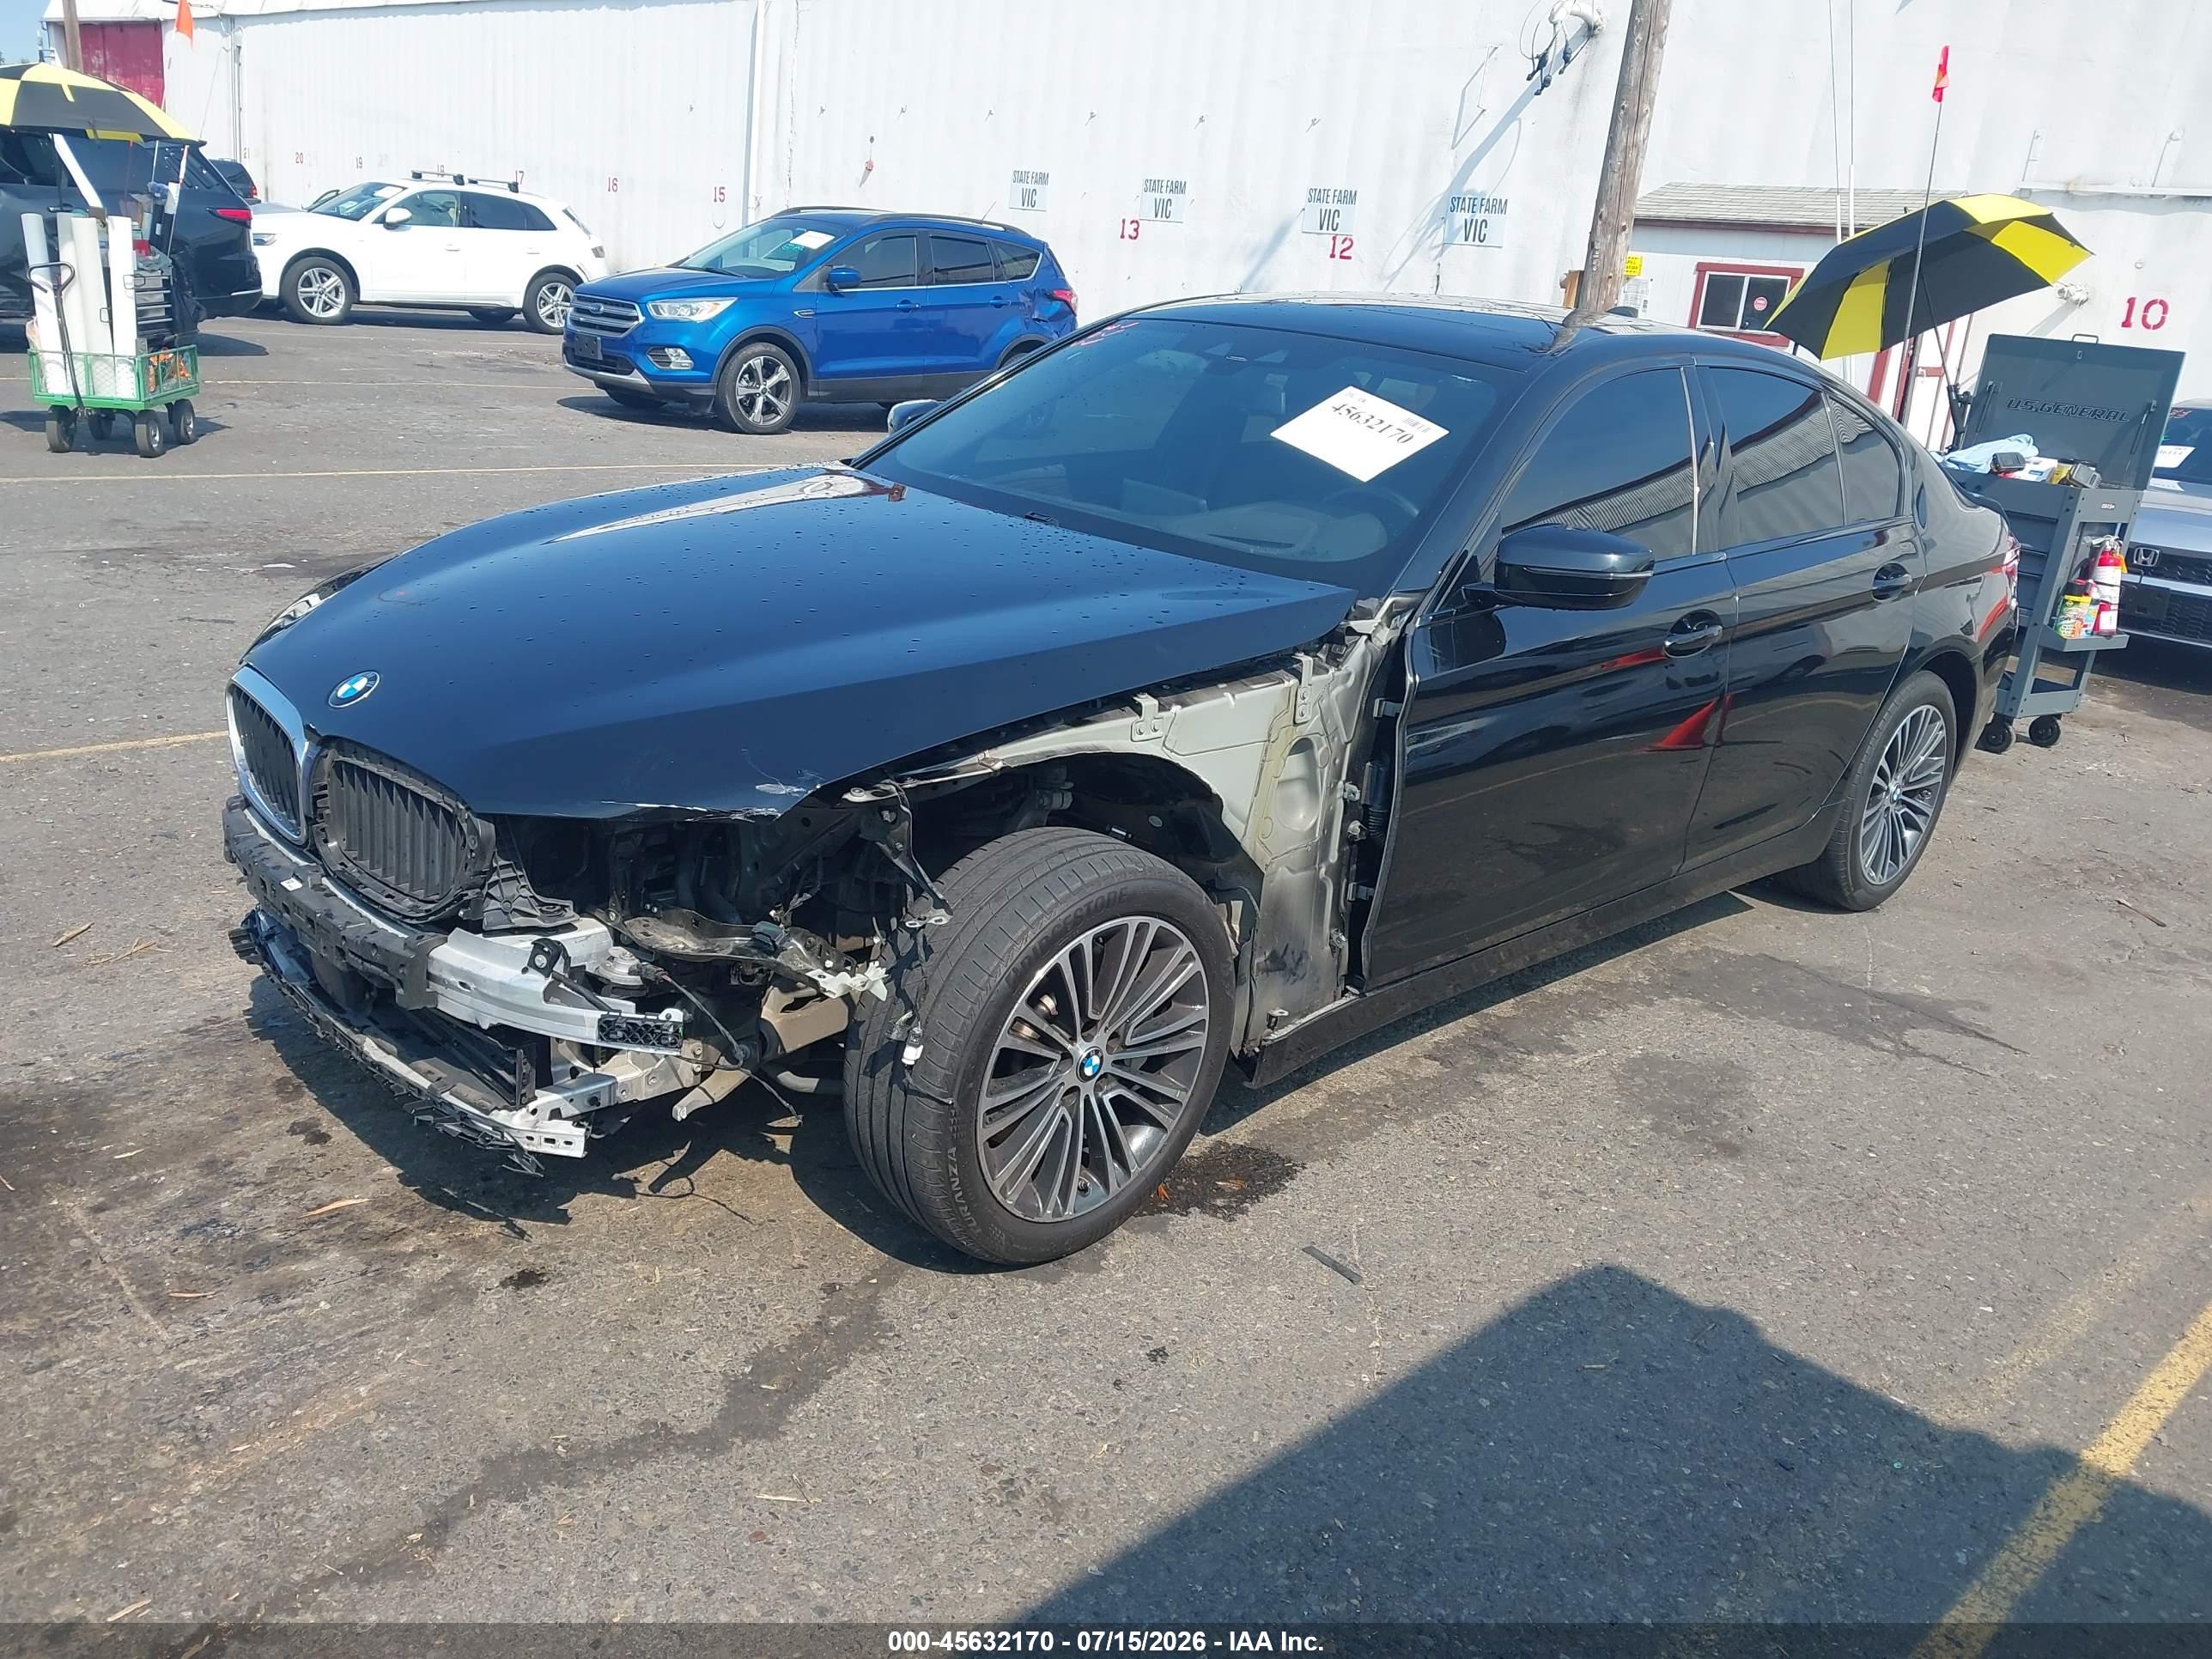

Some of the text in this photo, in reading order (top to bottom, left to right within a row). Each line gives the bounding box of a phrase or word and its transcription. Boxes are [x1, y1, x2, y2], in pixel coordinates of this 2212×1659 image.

[295, 152, 304, 164] 20
[356, 156, 363, 169] 19
[515, 169, 525, 185] 17
[607, 177, 618, 192] 16
[1012, 170, 1049, 186] STATE FARM
[1144, 179, 1187, 195] STATE FARM
[714, 186, 726, 203] 15
[1021, 187, 1037, 208] VIC
[1307, 187, 1358, 205] STATE FARM
[1154, 198, 1172, 219] VIC
[1449, 196, 1509, 216] STATE FARM
[1120, 218, 1140, 240] 13
[1318, 208, 1340, 232] VIC
[1463, 218, 1488, 244] VIC
[1329, 235, 1354, 260] 12
[2121, 297, 2169, 331] 10
[2039, 402, 2130, 422] GENERAL
[1331, 403, 1414, 444] 45632170
[947, 1146, 982, 1236] TURANZA
